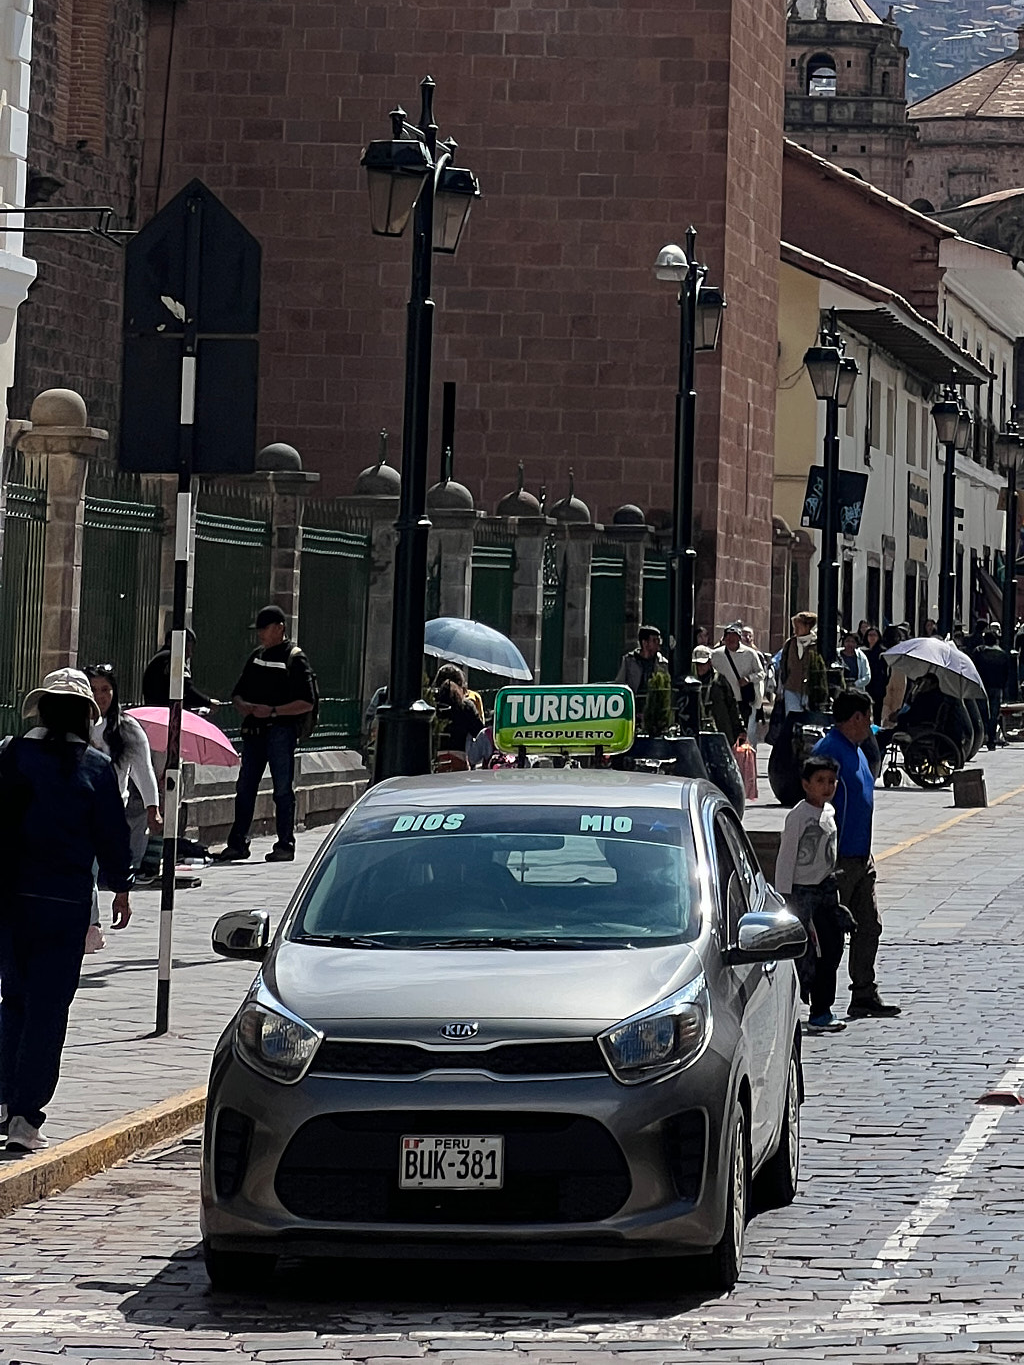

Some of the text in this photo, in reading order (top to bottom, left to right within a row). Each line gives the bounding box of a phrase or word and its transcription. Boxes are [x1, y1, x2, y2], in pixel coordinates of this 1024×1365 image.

[506, 694, 625, 724] TURISMO
[514, 730, 614, 739] AEROPUERTO
[392, 813, 633, 833] DIOS MIO
[445, 1024, 472, 1035] KIA
[434, 1138, 471, 1149] PERU
[404, 1149, 498, 1180] BUK-381
